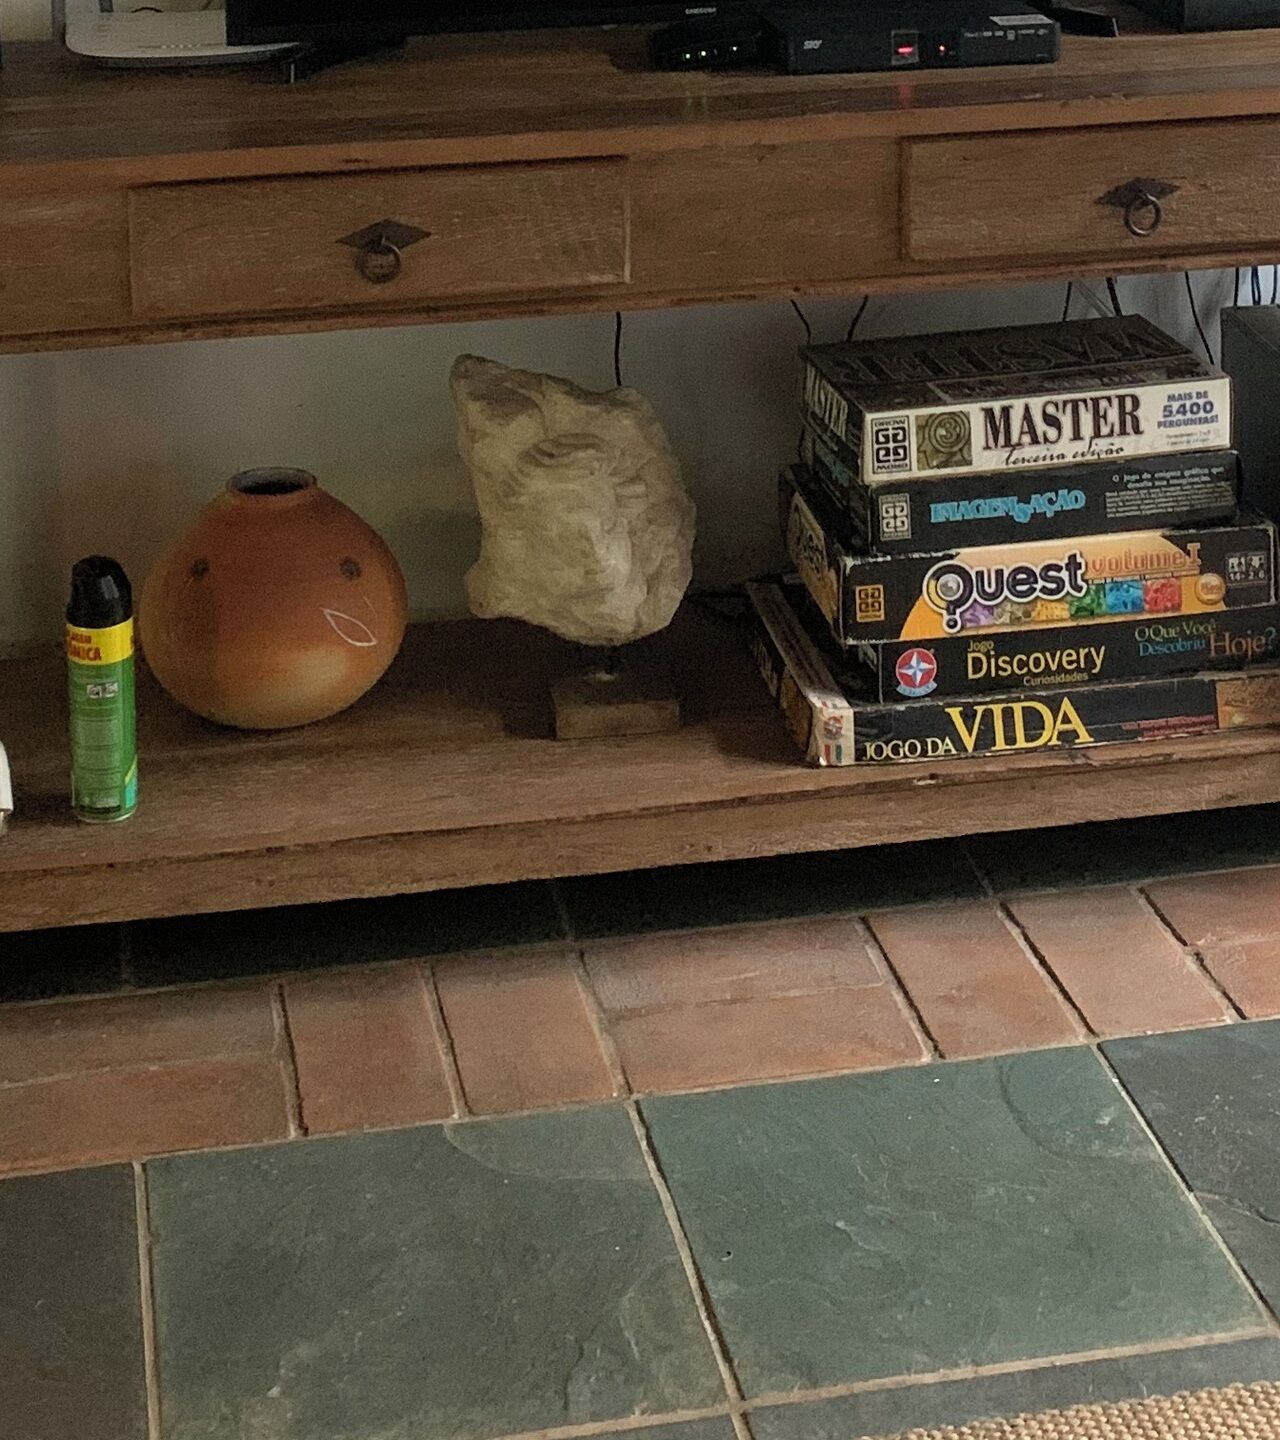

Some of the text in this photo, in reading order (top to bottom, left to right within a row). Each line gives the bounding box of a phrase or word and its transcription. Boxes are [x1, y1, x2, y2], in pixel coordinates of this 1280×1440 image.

[1166, 392, 1192, 402] MAIS
[1195, 390, 1209, 400] DE
[981, 394, 1144, 451] MASTER
[1157, 414, 1219, 430] PERGUNTAS!
[922, 550, 1087, 633] Quest
[1090, 546, 1184, 574] volume
[1135, 618, 1217, 642] O Que Você
[968, 640, 994, 653] Jogo
[1139, 636, 1207, 657] Descobriu
[1209, 626, 1277, 659] Hoje?
[967, 644, 1106, 680] Discovery
[1023, 671, 1089, 687] Curiosidades
[863, 738, 922, 762] JOGO
[926, 736, 958, 757] DA
[943, 696, 1095, 753] VIDA
